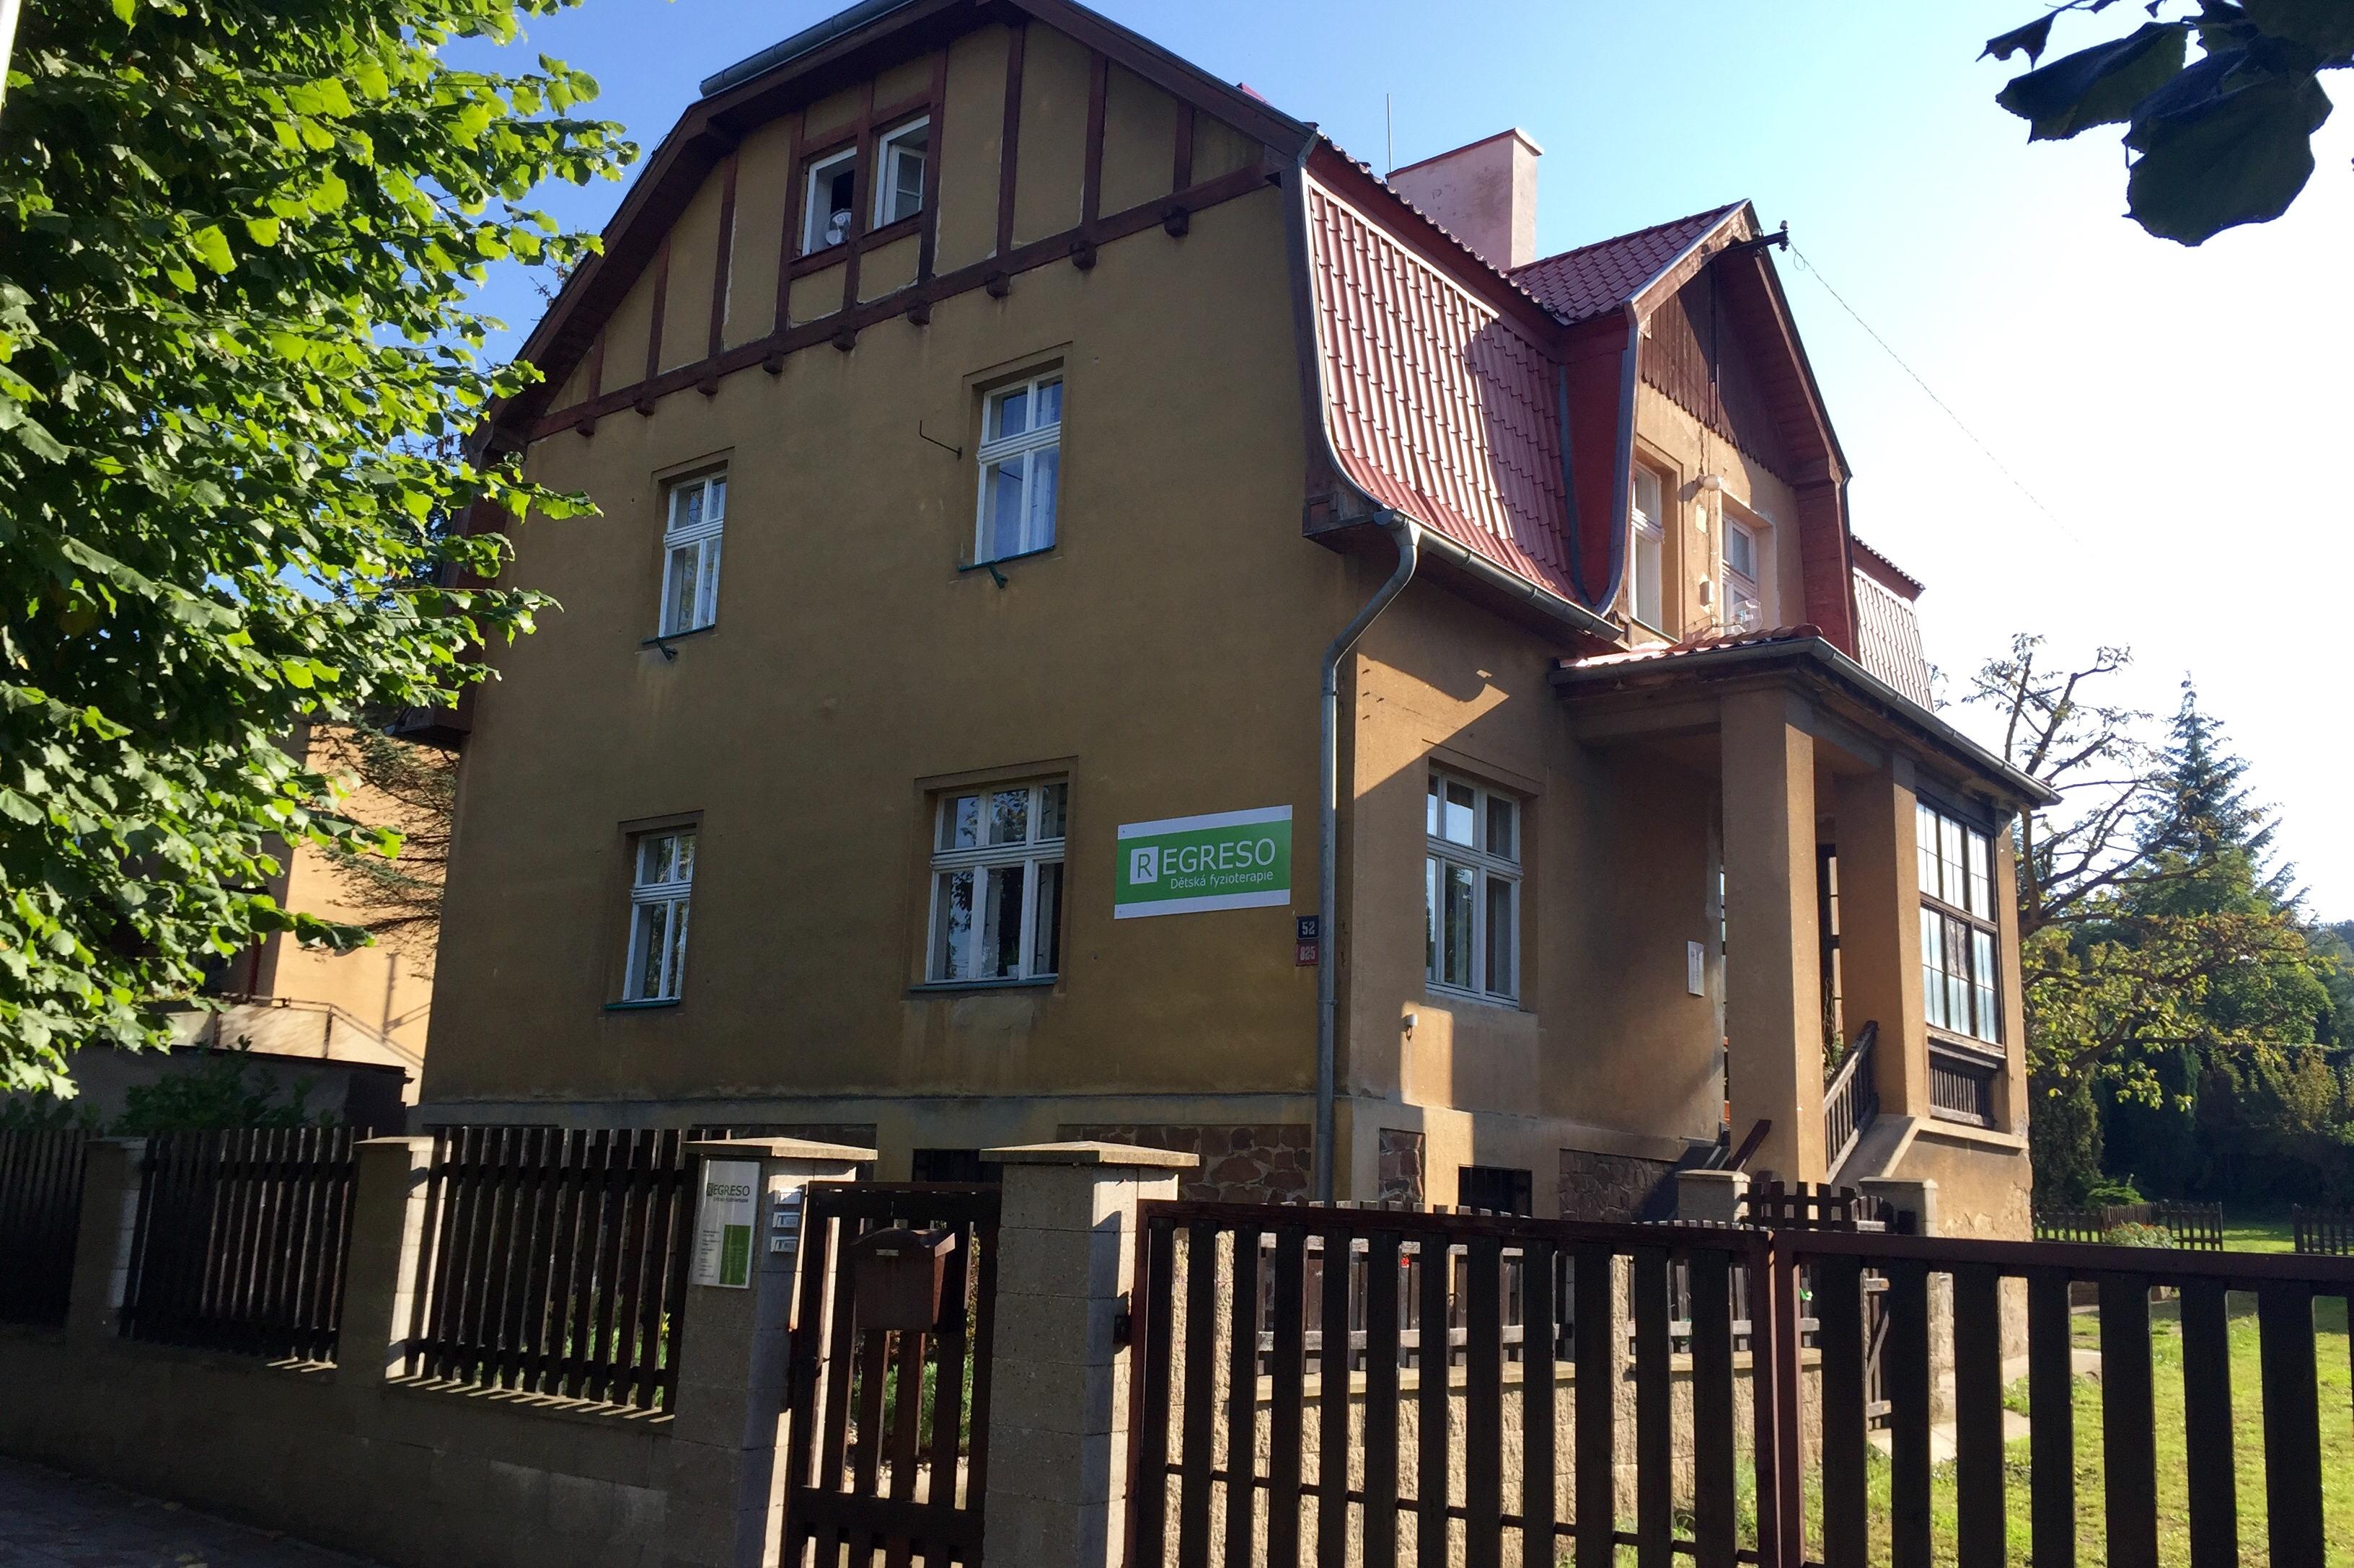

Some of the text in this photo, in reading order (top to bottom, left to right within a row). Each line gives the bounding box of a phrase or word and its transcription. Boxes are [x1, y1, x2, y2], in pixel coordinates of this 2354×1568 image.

[1137, 838, 1276, 878] REGRESO
[1171, 871, 1274, 889] Dětská fyzioterapie
[1302, 921, 1315, 935] 52
